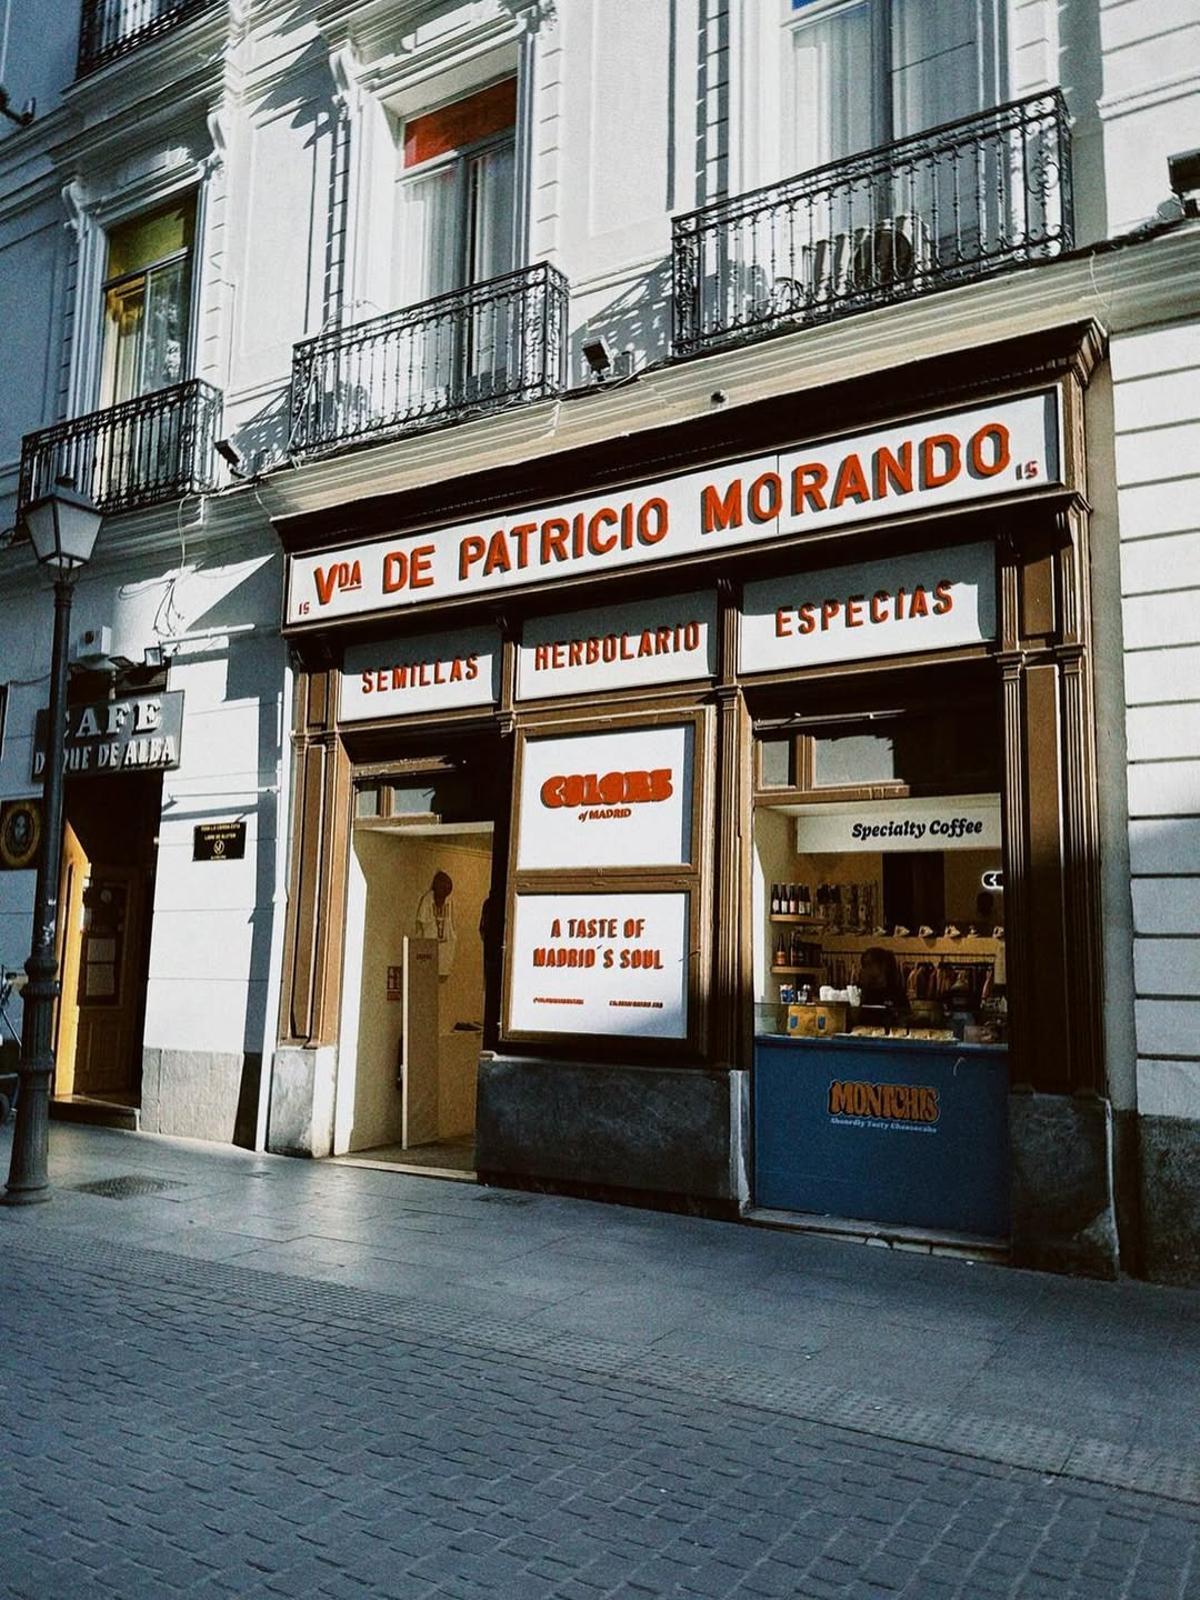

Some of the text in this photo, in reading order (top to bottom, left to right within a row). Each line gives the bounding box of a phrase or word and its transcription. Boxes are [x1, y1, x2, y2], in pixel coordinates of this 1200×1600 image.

[382, 544, 436, 594] DE
[458, 496, 670, 580] PATRICIO
[701, 422, 1011, 535] MORANDO
[775, 579, 954, 639] ESPECIAS
[534, 620, 701, 671] HERBOLARIO
[362, 653, 480, 694] SEMILLAS
[64, 698, 162, 738] AFE
[34, 736, 176, 774] DUE DE ALBA
[540, 768, 673, 808] COLORS
[578, 808, 632, 822] of MADRID
[852, 819, 983, 840] Specialty Coffee
[550, 918, 646, 939] A TASTE OF
[619, 948, 664, 970] SOUL
